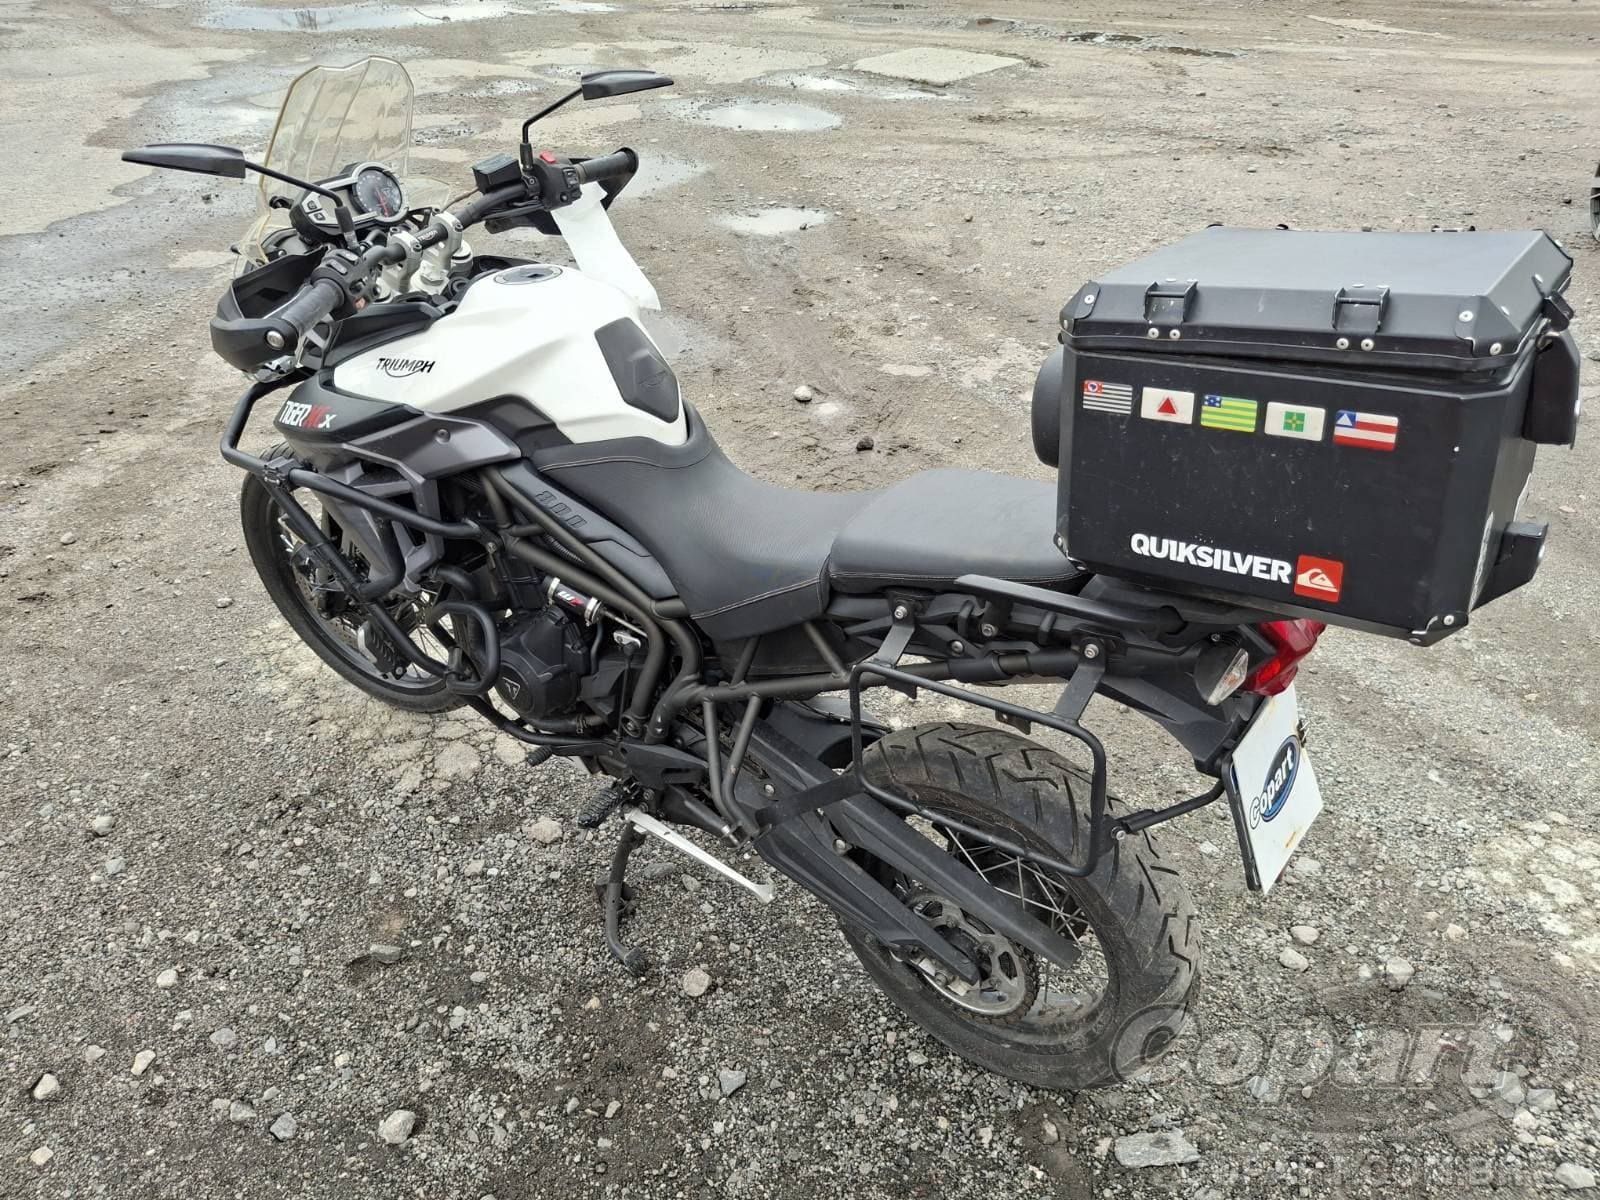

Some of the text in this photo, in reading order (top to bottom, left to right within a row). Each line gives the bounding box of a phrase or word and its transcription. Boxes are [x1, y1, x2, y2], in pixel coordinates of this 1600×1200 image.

[376, 358, 436, 378] TRIUMPH
[278, 400, 312, 427] TIGER
[535, 490, 588, 529] 800
[1131, 533, 1292, 584] QUIKSILVER
[1249, 746, 1295, 830] Copart
